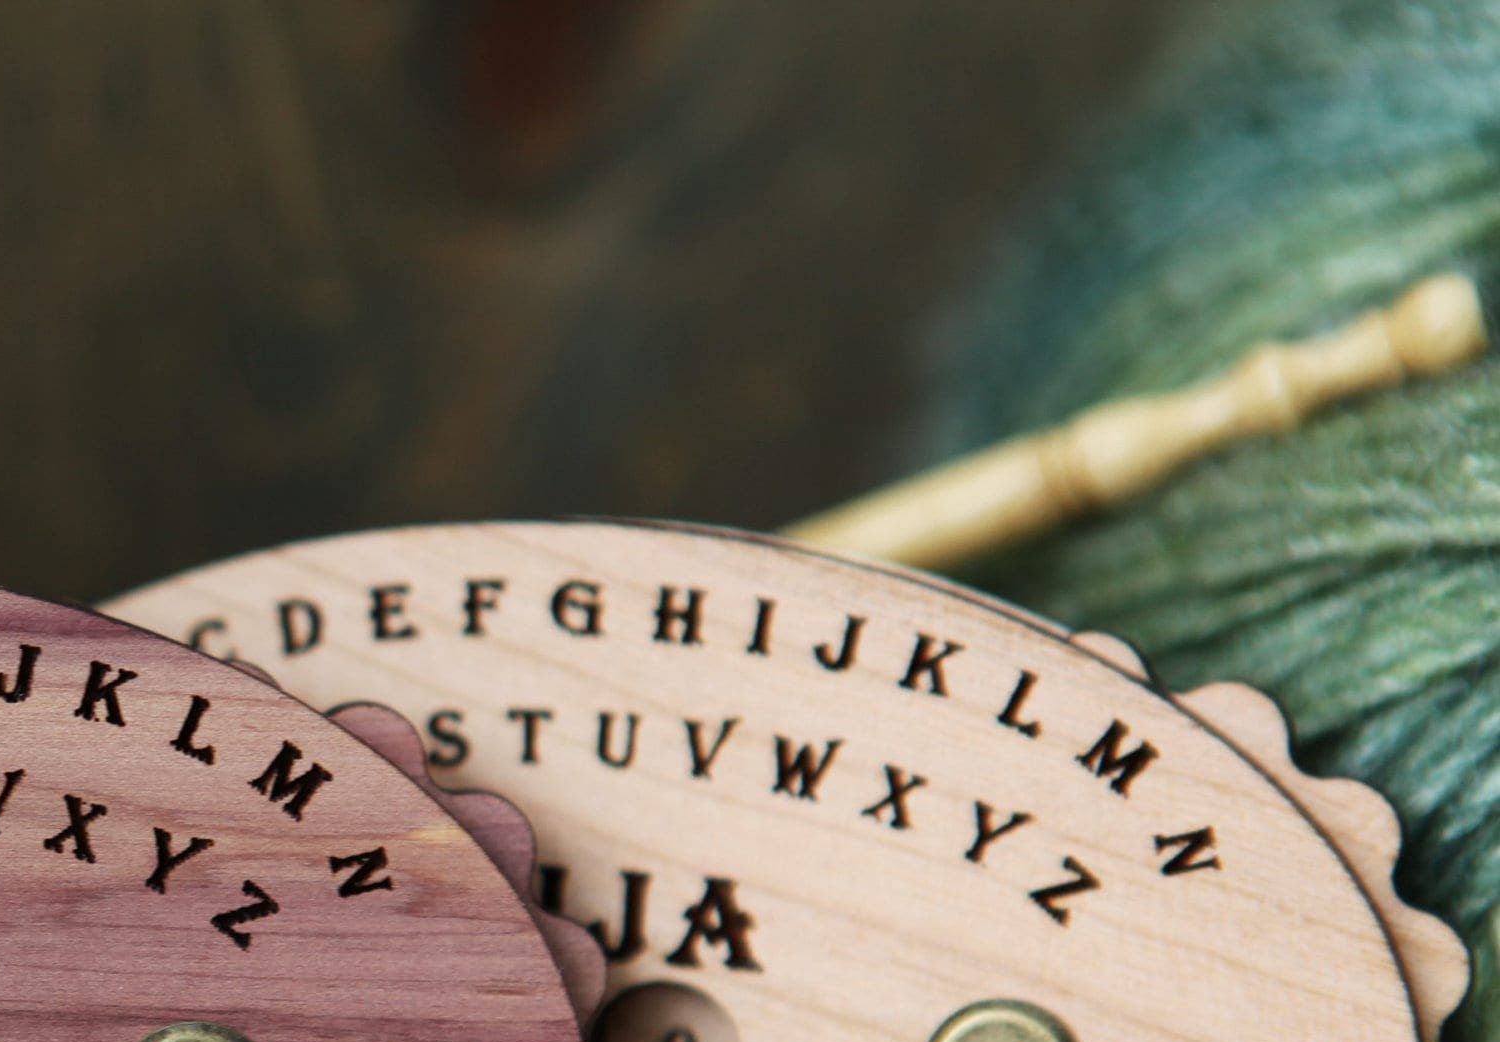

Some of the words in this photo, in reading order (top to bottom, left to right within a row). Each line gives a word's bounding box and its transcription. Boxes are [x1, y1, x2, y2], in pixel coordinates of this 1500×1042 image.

[73, 659, 139, 728] K
[169, 694, 216, 766] L
[246, 739, 333, 823] M
[327, 846, 395, 899] N
[277, 599, 323, 657] D
[369, 585, 416, 641] E
[462, 579, 505, 637] F
[549, 581, 601, 636] G
[653, 586, 703, 645] H
[746, 599, 773, 655] I
[813, 615, 865, 673] J
[897, 633, 962, 697] K
[996, 670, 1040, 739] L
[1075, 719, 1158, 796] M
[1154, 827, 1220, 877] N
[427, 711, 471, 767] S
[506, 709, 552, 765] T
[596, 712, 639, 769] U
[684, 718, 737, 778] V
[772, 736, 841, 801] W
[861, 764, 926, 831] X
[964, 800, 1032, 864] Y
[1028, 856, 1100, 925] Z
[43, 793, 108, 865] X
[144, 826, 215, 895] Y
[209, 879, 280, 952] Z
